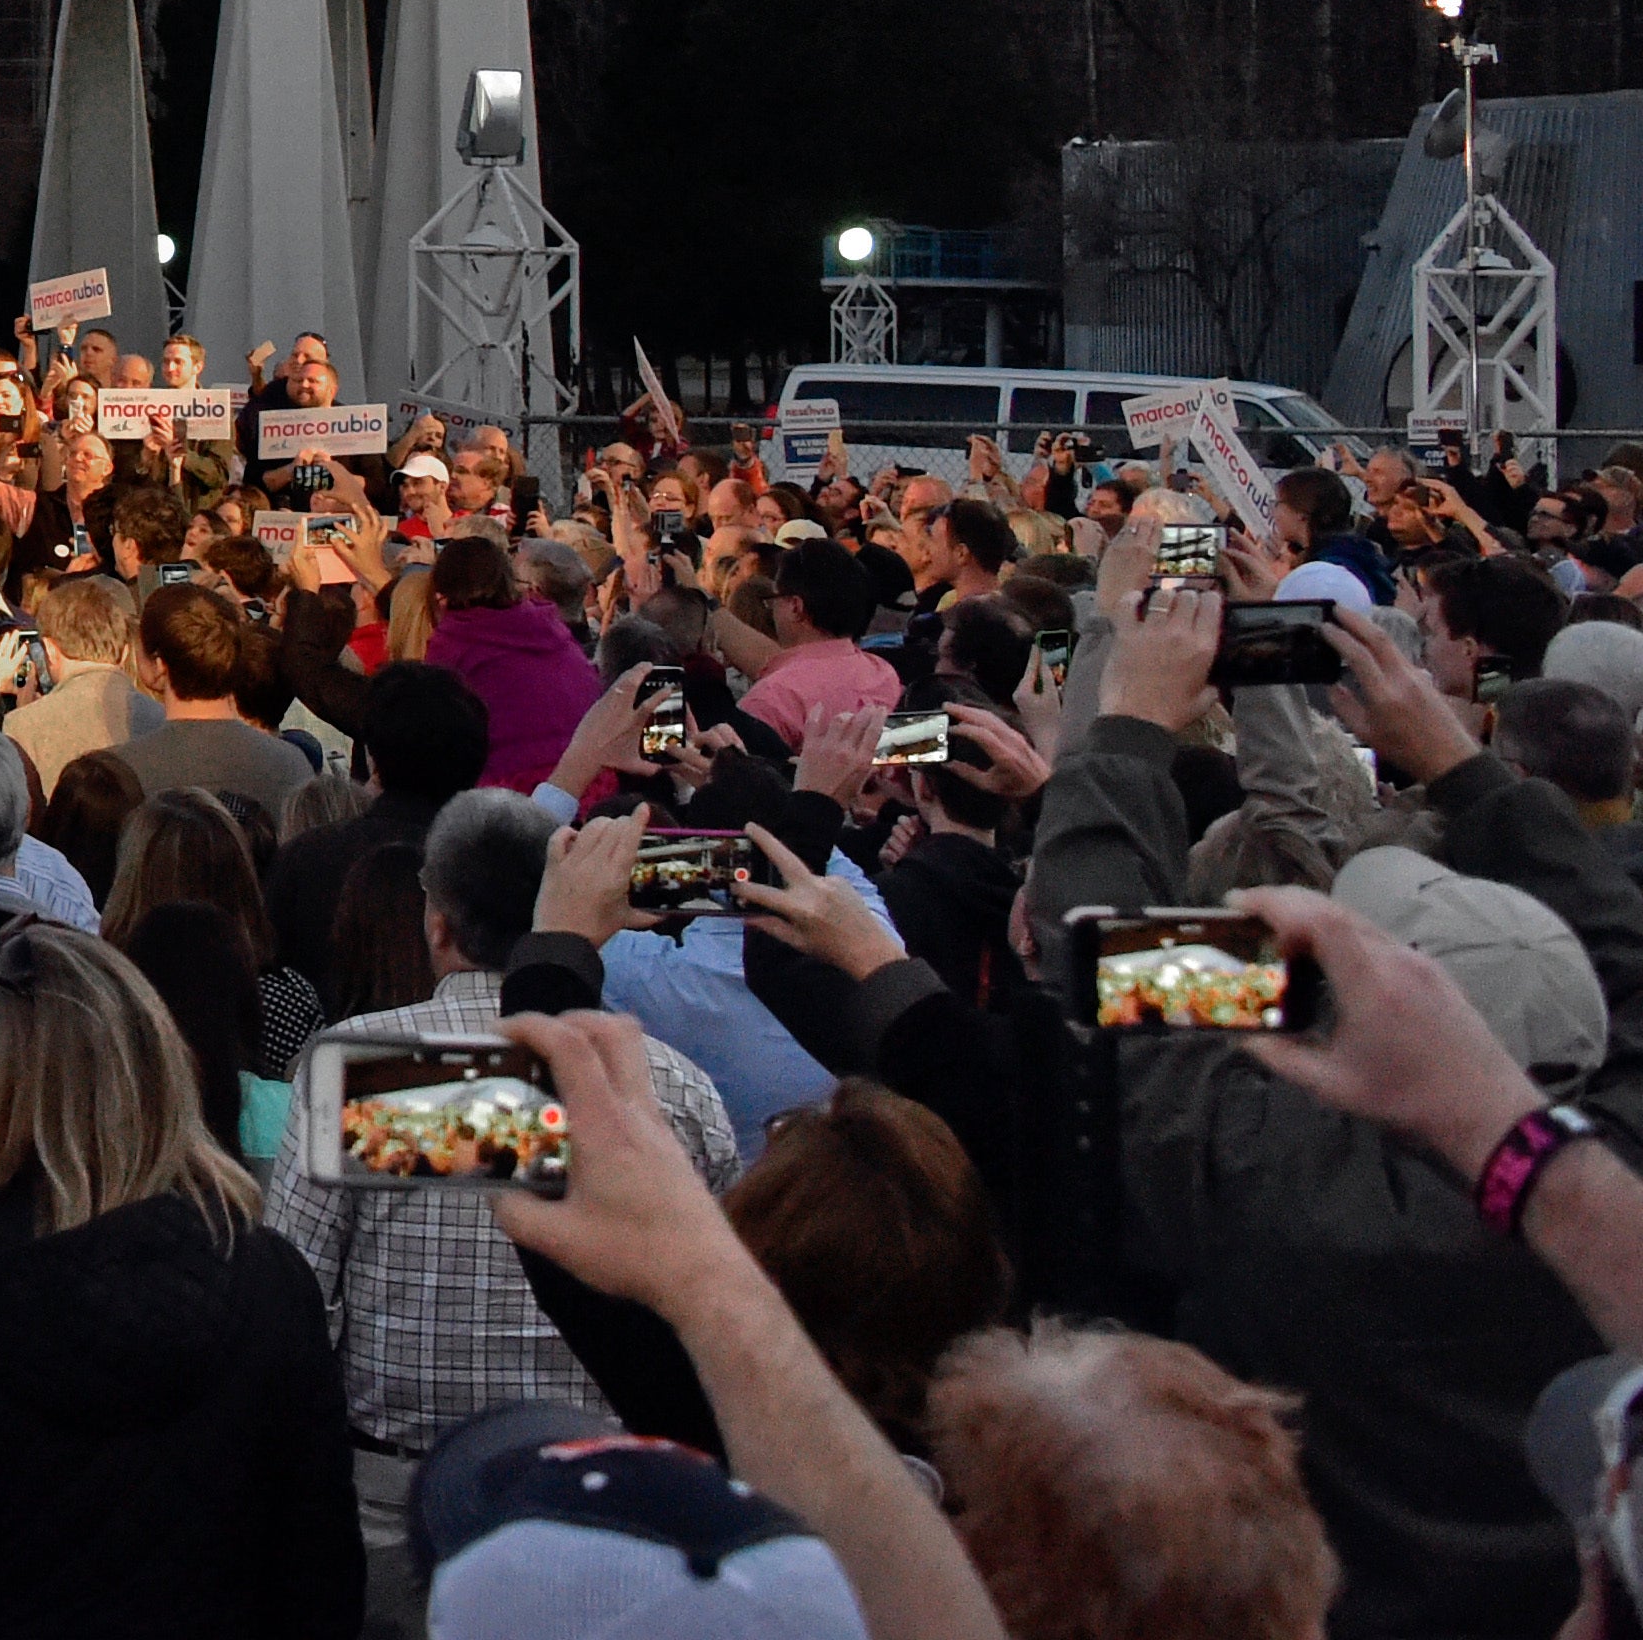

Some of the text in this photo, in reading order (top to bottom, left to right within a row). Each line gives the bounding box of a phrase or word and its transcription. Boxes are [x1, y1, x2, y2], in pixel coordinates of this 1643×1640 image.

[33, 278, 105, 310] marcorubio
[103, 397, 225, 418] marcorubio
[785, 407, 835, 417] RESERVED
[263, 412, 382, 438] marcorubio
[1412, 418, 1467, 427] RESERVED
